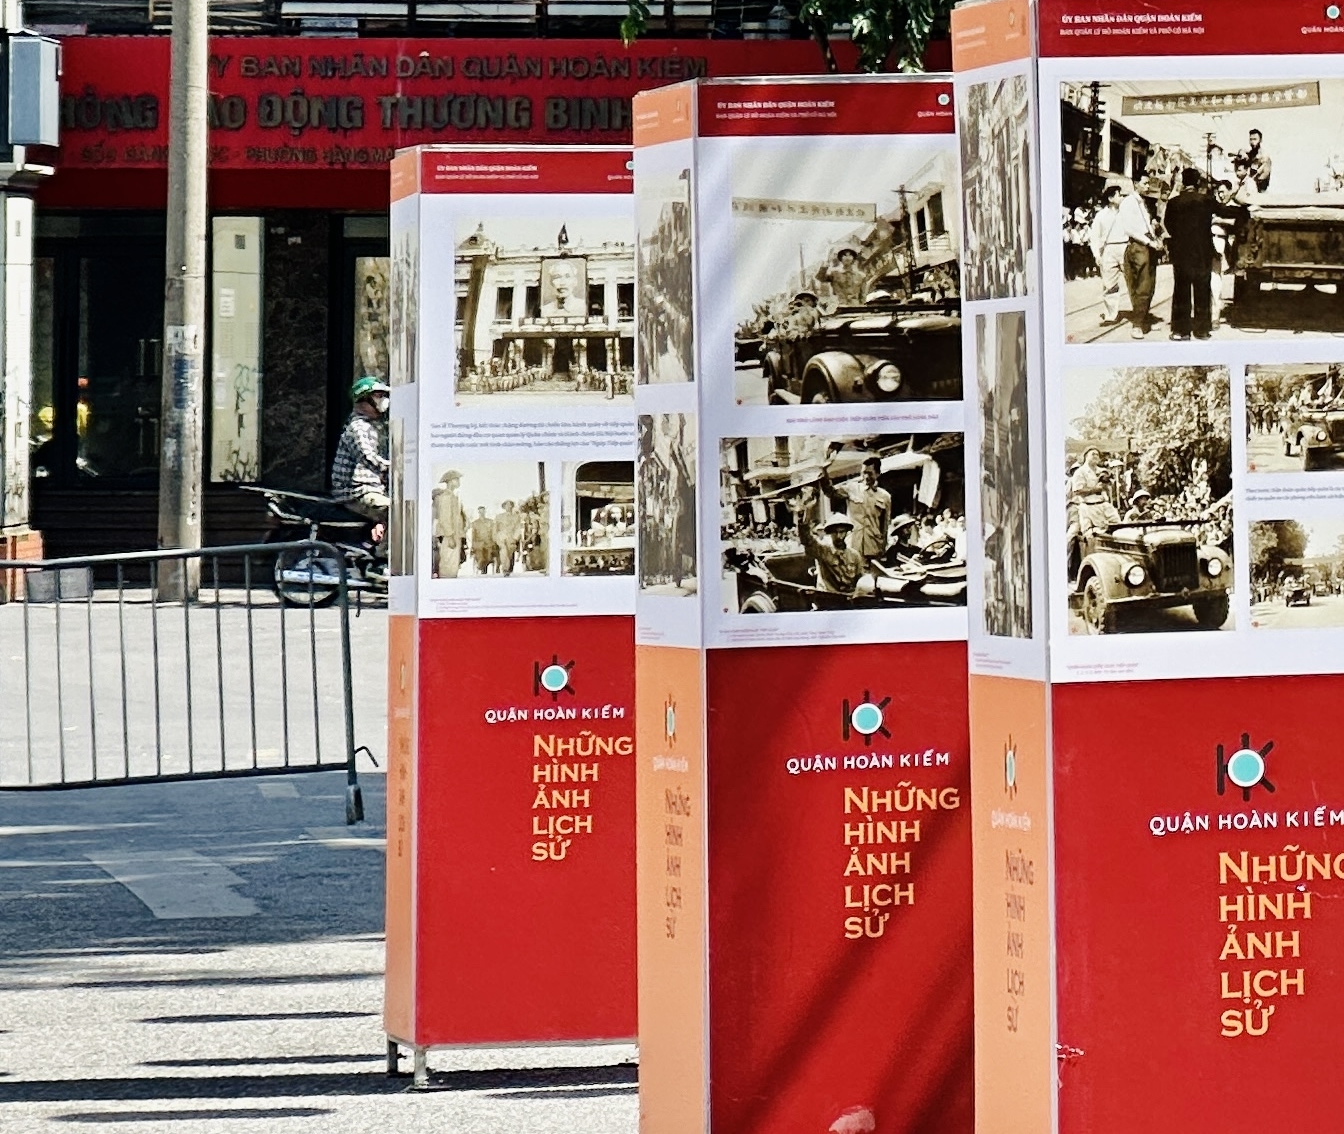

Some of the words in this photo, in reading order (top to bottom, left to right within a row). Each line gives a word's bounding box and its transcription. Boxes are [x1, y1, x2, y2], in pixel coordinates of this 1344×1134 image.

[208, 55, 231, 78] Y
[241, 55, 301, 77] BAN
[309, 50, 388, 78] NHÂN
[395, 52, 454, 78] DÂN
[461, 51, 543, 80] QUẬN
[549, 50, 630, 79] HOÀN
[258, 87, 364, 135] ĐỘNG
[376, 92, 531, 130] THƯƠNG
[484, 708, 529, 724] QUẬN
[533, 706, 577, 721] HOÀN
[582, 703, 625, 719] KIẾM
[532, 759, 599, 784] HÌNH
[785, 756, 838, 775] QUẬN
[843, 753, 894, 770] HOÀN
[900, 750, 951, 768] KIẾM
[532, 784, 591, 810] ẢNH
[843, 780, 960, 814] NHỮNG
[532, 815, 593, 838] LỊCH
[843, 819, 922, 845] HÌNH
[1149, 811, 1210, 836] QUẬN
[1218, 808, 1278, 830] HOÀN
[532, 837, 572, 862] SỬ
[843, 847, 911, 877] ẢNH
[843, 882, 915, 912] LỊCH
[1219, 887, 1312, 922] HÌNH
[843, 910, 890, 940] SỬ
[1219, 923, 1301, 961] ẢNH
[1220, 968, 1305, 1004] LỊCH
[1220, 998, 1276, 1038] SỬ
